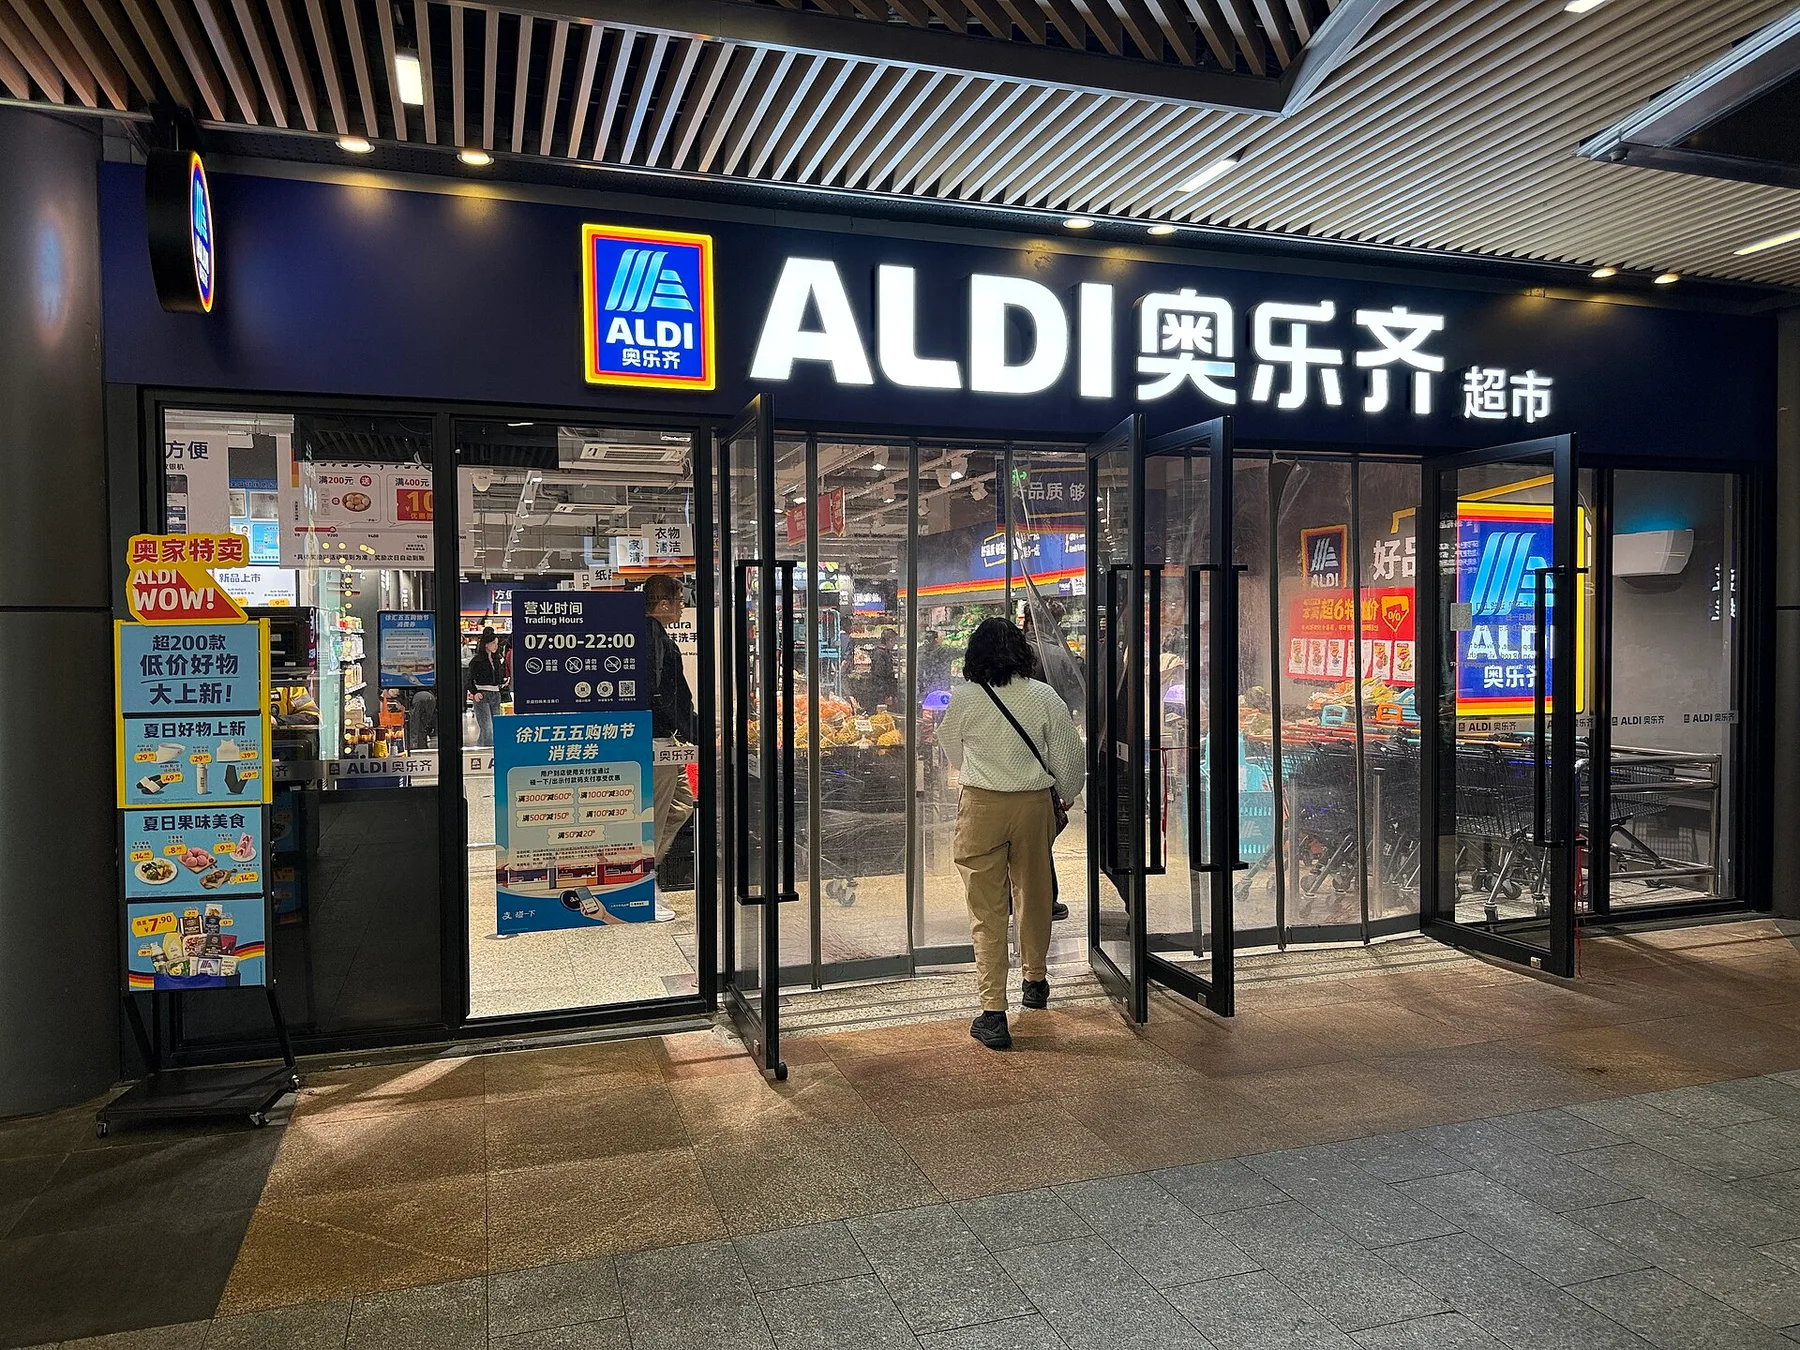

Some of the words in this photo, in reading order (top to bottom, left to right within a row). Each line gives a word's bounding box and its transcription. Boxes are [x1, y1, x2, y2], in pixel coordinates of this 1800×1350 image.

[605, 316, 694, 348] ALDI
[749, 256, 1114, 398] ALDI
[1136, 288, 1445, 415] 奥乐齐
[622, 347, 681, 370] 奥乐齐
[1463, 365, 1554, 423] 超市
[165, 440, 209, 460] 方便
[318, 475, 354, 485] 满200元
[395, 477, 430, 487] 满400元
[655, 527, 680, 539] 衣物
[133, 538, 244, 564] 奥家特卖
[628, 539, 643, 550] 家
[655, 541, 681, 553] 清洁
[629, 552, 644, 562] 清
[133, 569, 178, 585] ALDI
[218, 573, 262, 584] 新品上市
[1311, 573, 1339, 587] ALDI
[132, 587, 215, 611] WOW!
[524, 601, 583, 615] 营业时间
[524, 616, 557, 625] Trading
[559, 616, 584, 624] Hours
[152, 634, 227, 651] 超200款
[524, 633, 635, 650] 07:00-22:00
[139, 653, 239, 676] 低价好物
[1621, 716, 1641, 725] ALDI
[1643, 715, 1665, 724] 奥乐齐
[1692, 714, 1713, 723] ALDI
[1714, 713, 1735, 722] 奥乐齐
[143, 721, 246, 738] 夏日好物上新
[515, 722, 636, 744] 徐汇五五购物节
[1468, 723, 1491, 731] ALDI
[1493, 722, 1517, 730] 奥乐齐
[548, 743, 599, 761] 消费券
[659, 750, 695, 762] 奥乐齐
[346, 762, 386, 774] ALDI
[392, 760, 432, 773] 奥乐齐
[143, 813, 246, 831] 夏日果味美食
